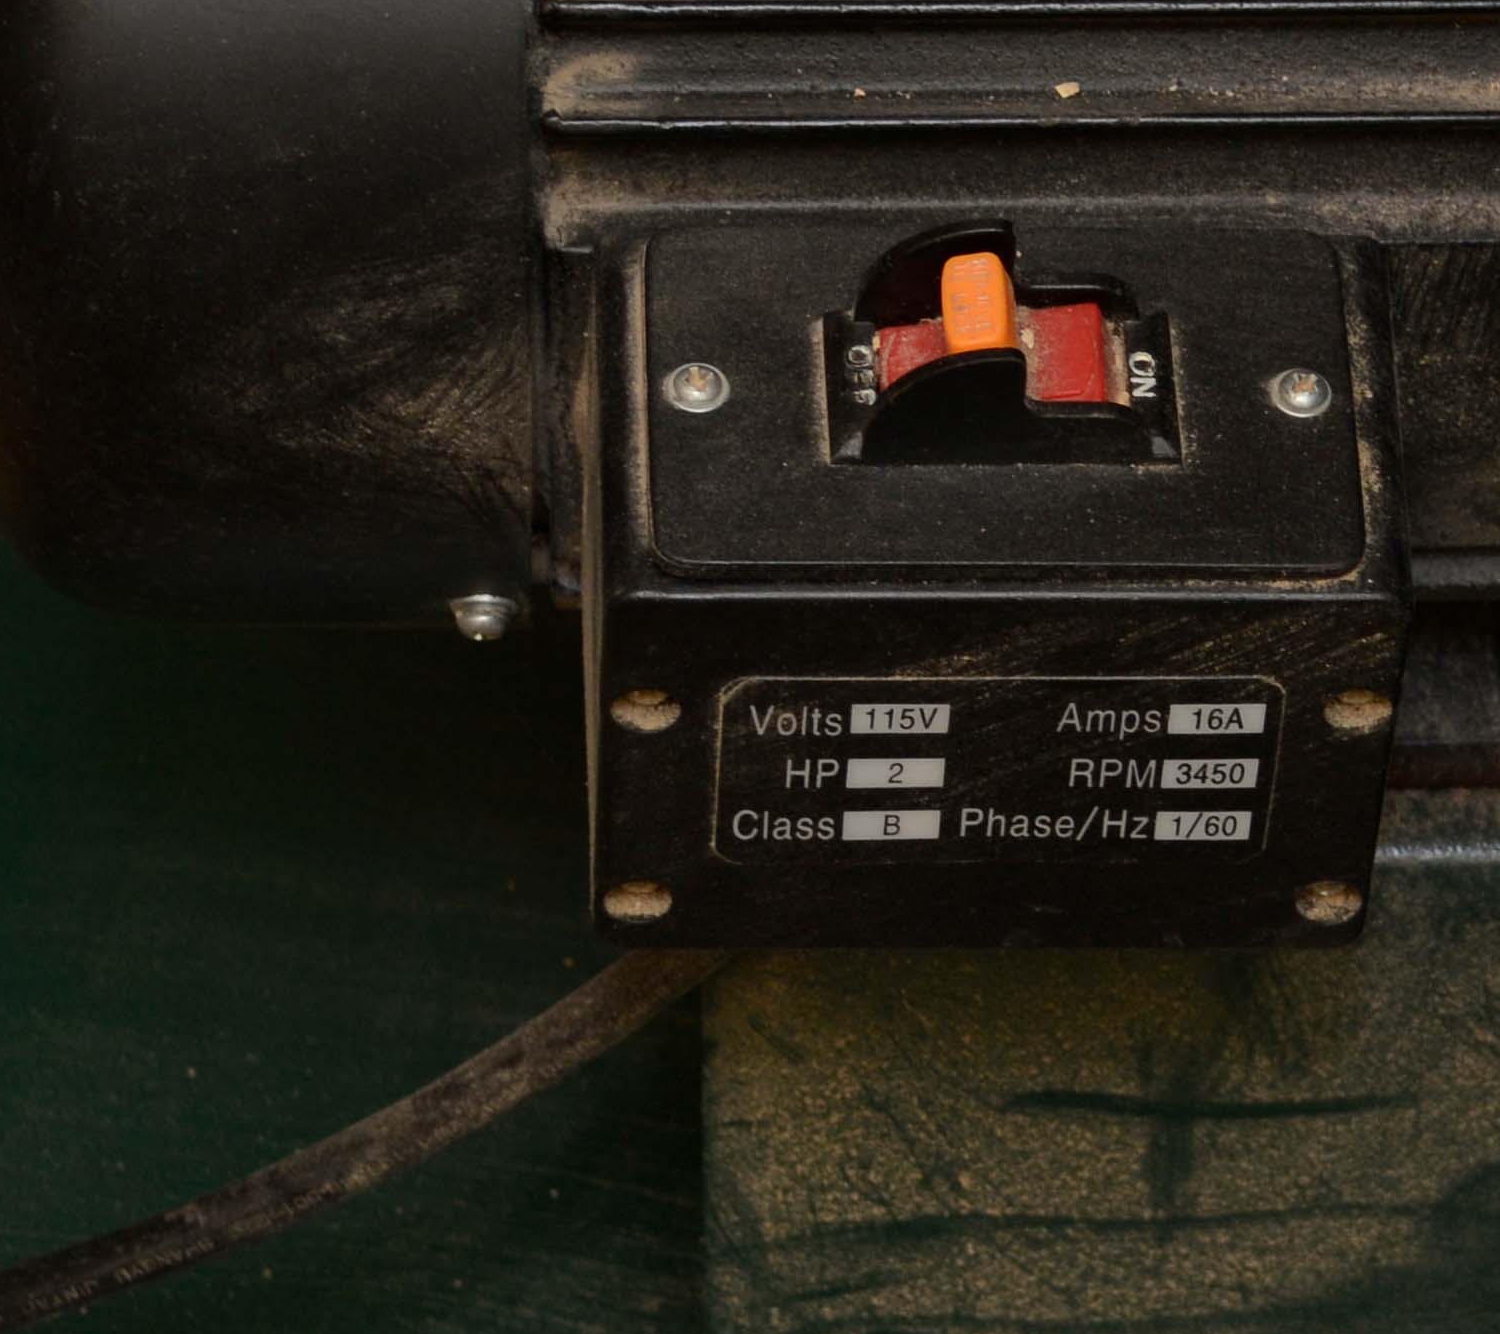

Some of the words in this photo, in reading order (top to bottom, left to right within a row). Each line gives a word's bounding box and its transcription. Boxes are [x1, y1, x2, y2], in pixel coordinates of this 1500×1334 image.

[1128, 350, 1158, 398] ON
[749, 704, 843, 736] Volts
[865, 708, 938, 730] 115V
[1056, 702, 1162, 740] Amps
[1191, 708, 1244, 730] 16A
[785, 758, 840, 789] HP
[887, 763, 904, 784] 2
[1068, 758, 1157, 788] RPM
[1175, 763, 1246, 785] 3450
[732, 809, 835, 841] Class
[882, 814, 901, 836] B
[959, 806, 1149, 841] Phase/Hz
[1171, 815, 1238, 839] 1/60
